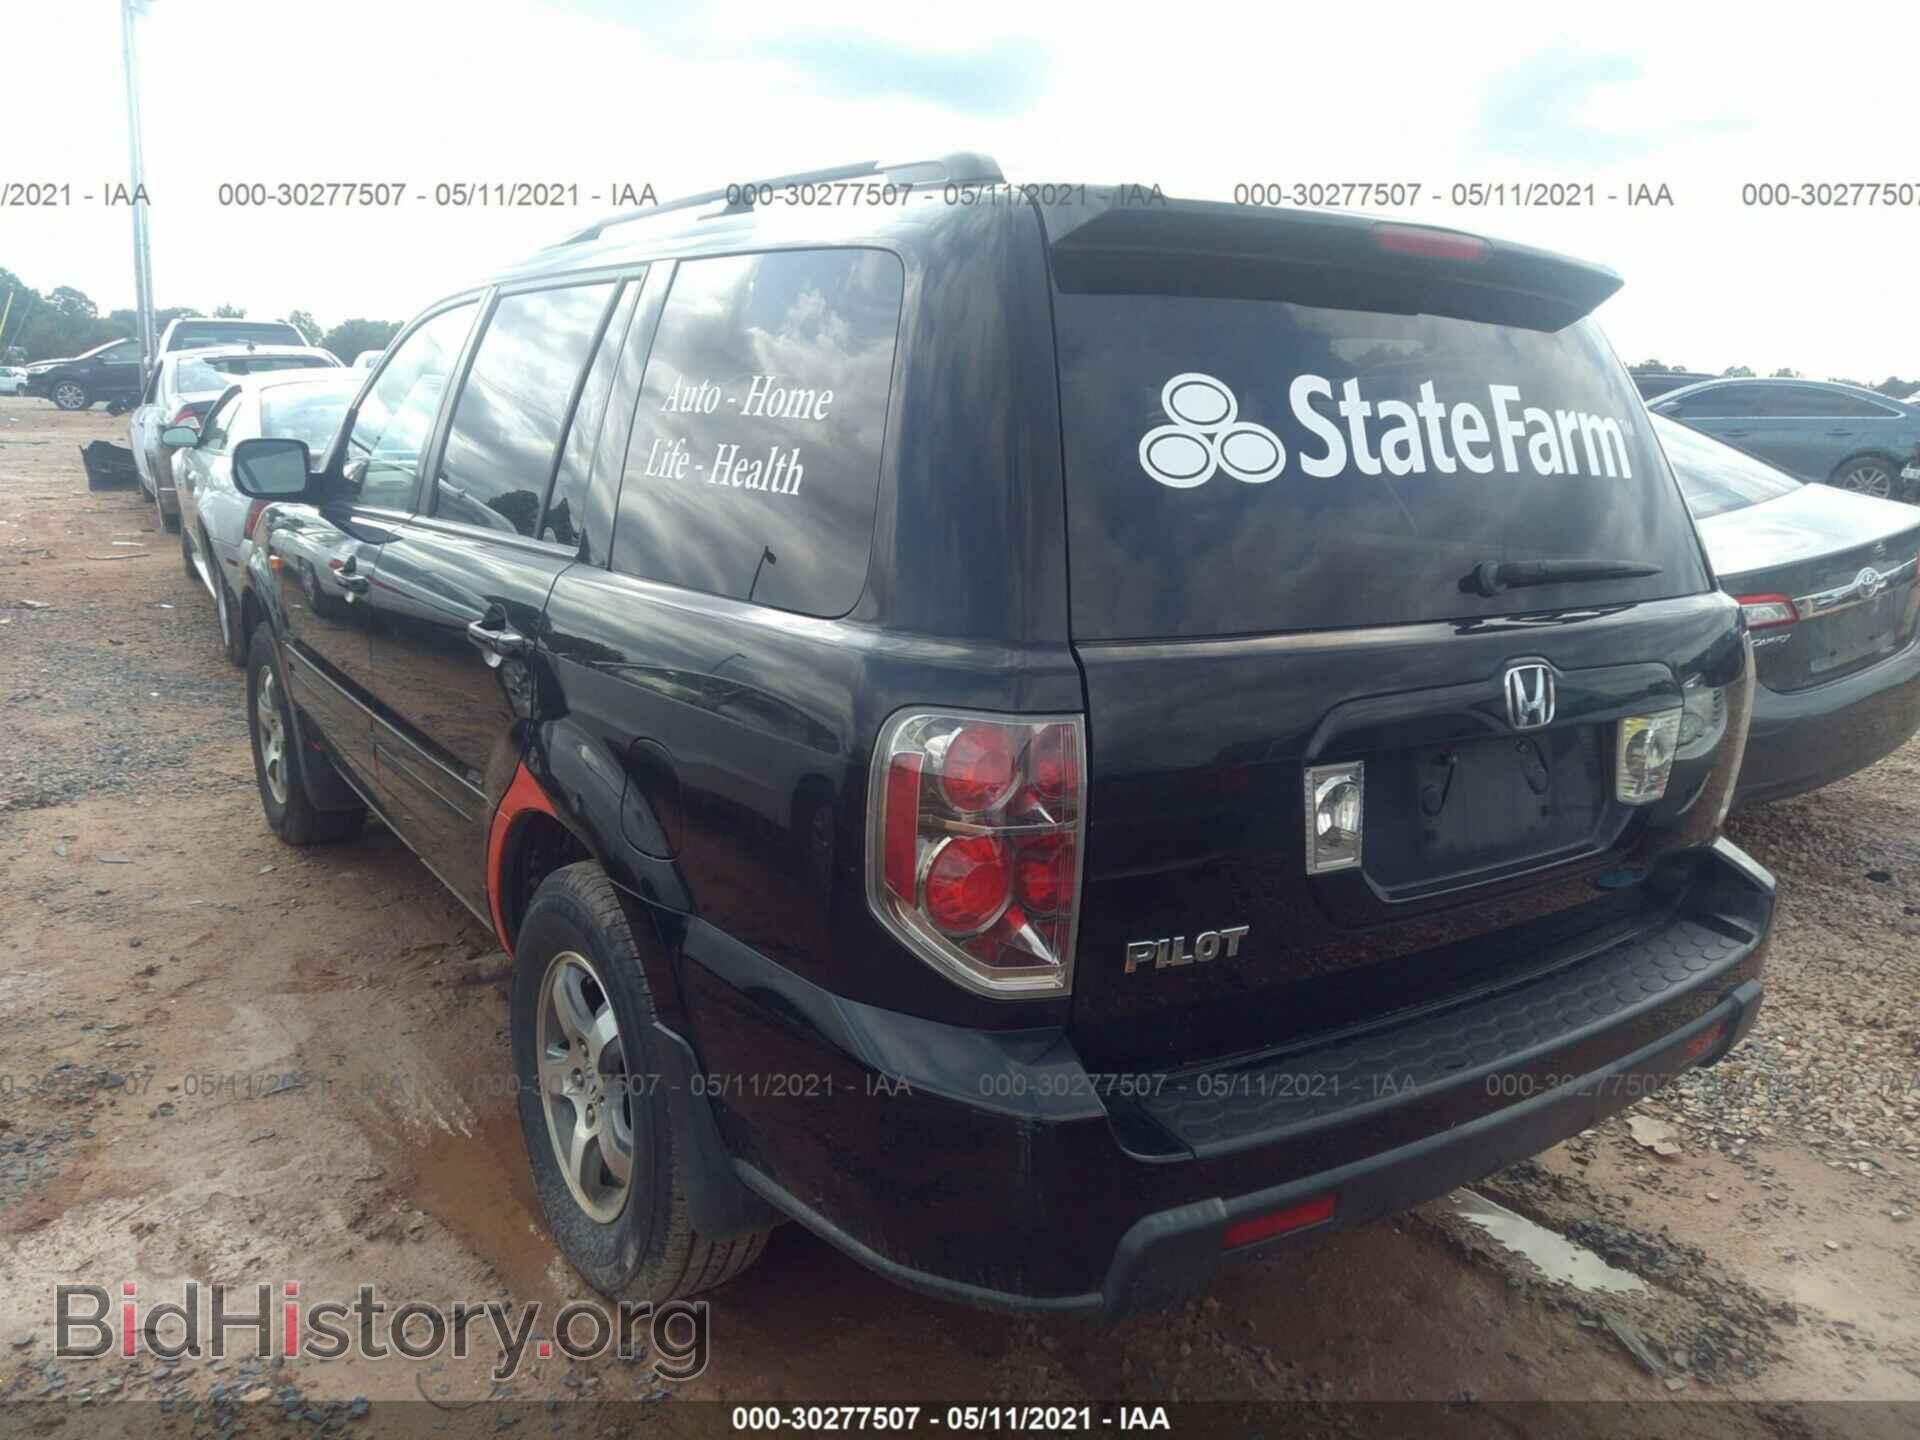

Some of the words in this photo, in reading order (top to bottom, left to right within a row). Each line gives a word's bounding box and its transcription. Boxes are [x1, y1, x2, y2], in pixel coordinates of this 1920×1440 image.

[660, 375, 722, 414] Auto
[740, 375, 834, 421] Home
[644, 437, 690, 480] Life
[707, 443, 804, 496] Health
[1124, 925, 1250, 974] PILOT
